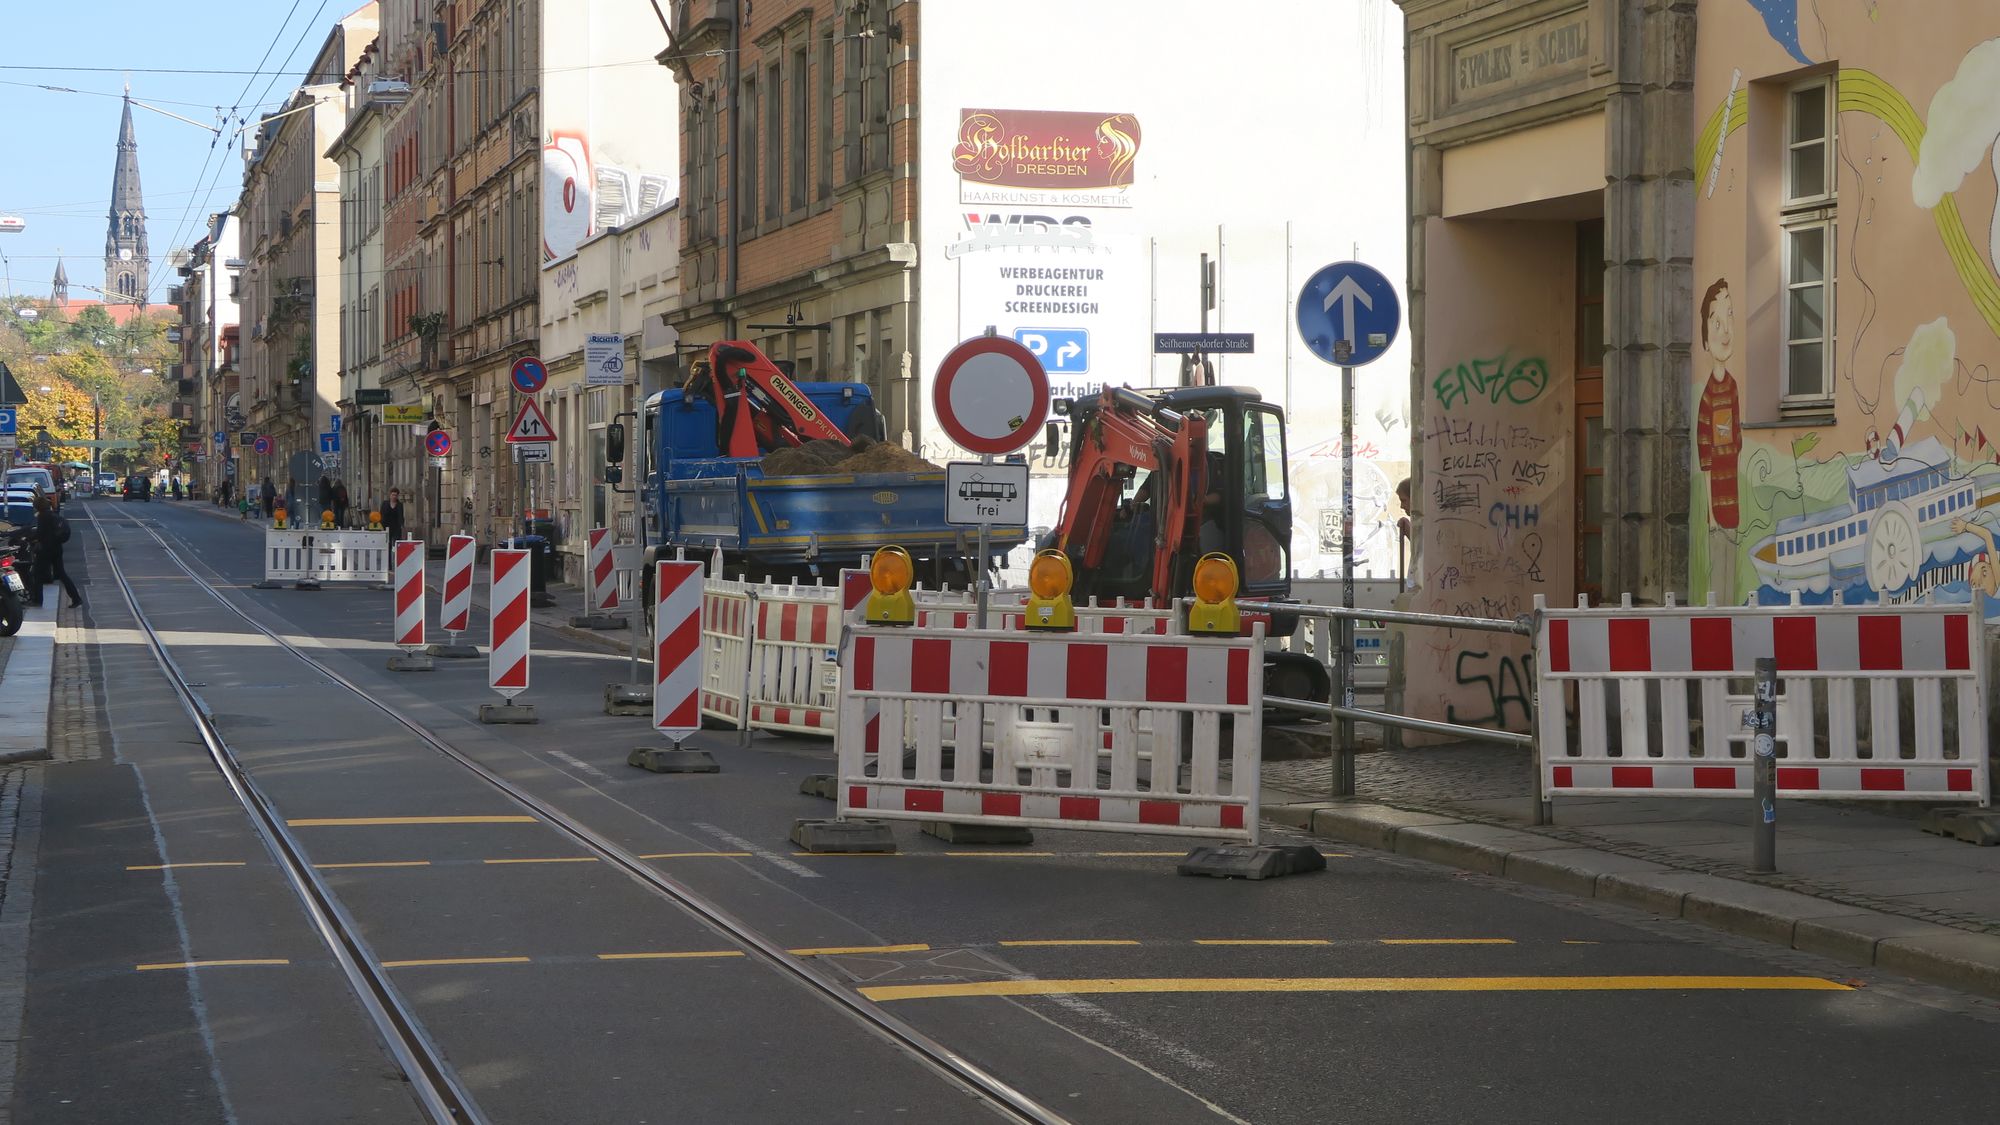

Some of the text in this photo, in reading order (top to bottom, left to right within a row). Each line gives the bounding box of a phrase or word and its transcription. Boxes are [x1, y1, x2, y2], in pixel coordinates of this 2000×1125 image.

[954, 112, 1091, 178] Hofbarbier
[1016, 163, 1088, 176] DRESDEN
[963, 191, 1131, 206] HAARKUNST & KOSMETIK
[963, 213, 1093, 247] WDS
[1000, 266, 1104, 281] WERBEAGENTUR
[1016, 284, 1088, 298] DRUCKEREI
[1005, 301, 1099, 315] SCREENDESIGN
[1225, 338, 1250, 349] Straße
[1050, 381, 1101, 398] arkplä
[772, 377, 814, 419] PALFINGER
[976, 504, 999, 516] frei
[1488, 501, 1539, 529] CHH
